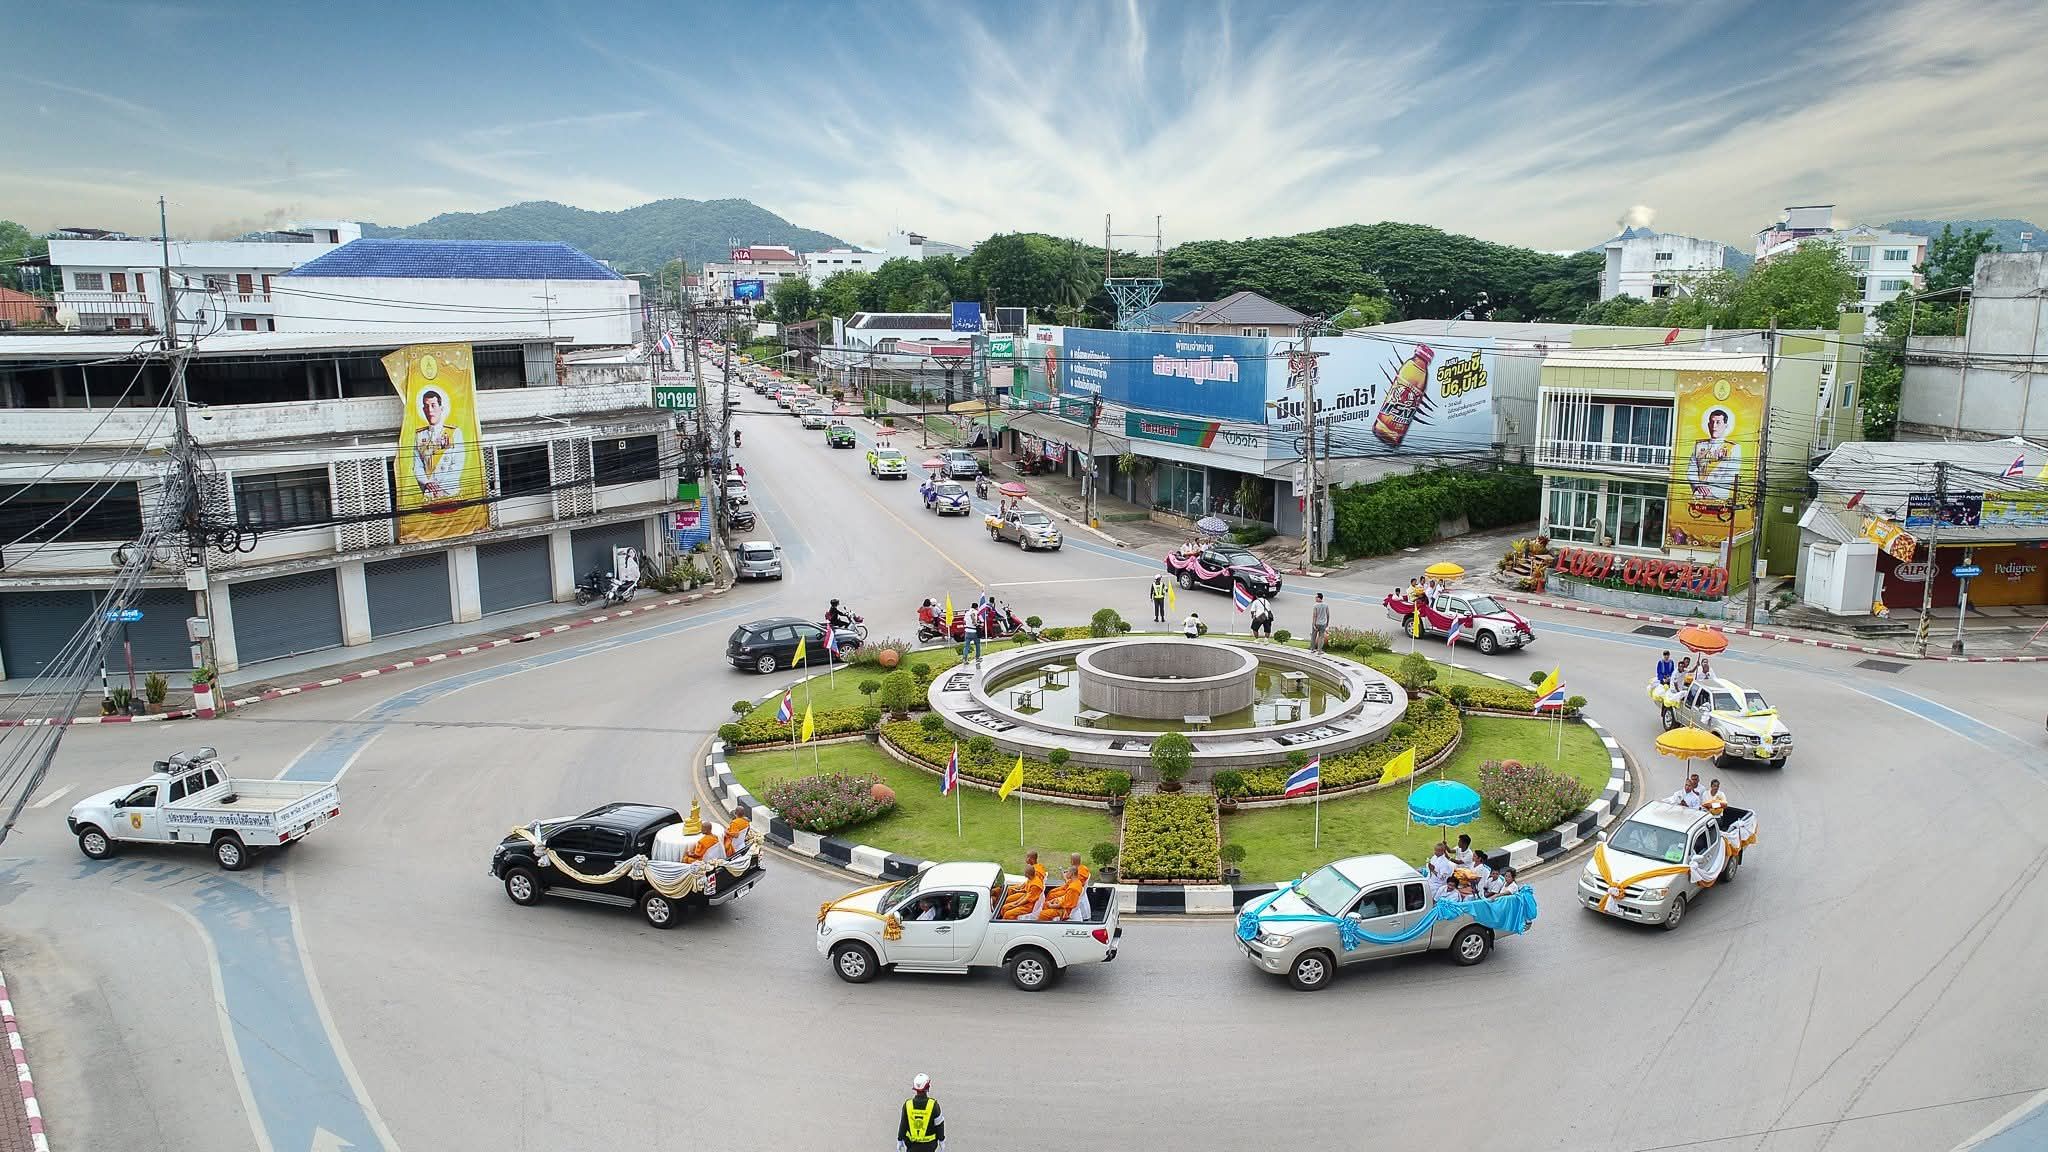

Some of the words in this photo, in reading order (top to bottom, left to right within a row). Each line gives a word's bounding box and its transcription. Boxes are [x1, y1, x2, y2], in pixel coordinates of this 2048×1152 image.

[733, 251, 750, 259] AIA
[1175, 339, 1214, 353] ผู้แทนจำหน่าย
[1153, 354, 1239, 385] สยามคูโบต้า
[1441, 370, 1488, 397] บี6,บี12
[656, 391, 698, 408] ขายย
[1994, 562, 2038, 576] Pedigree
